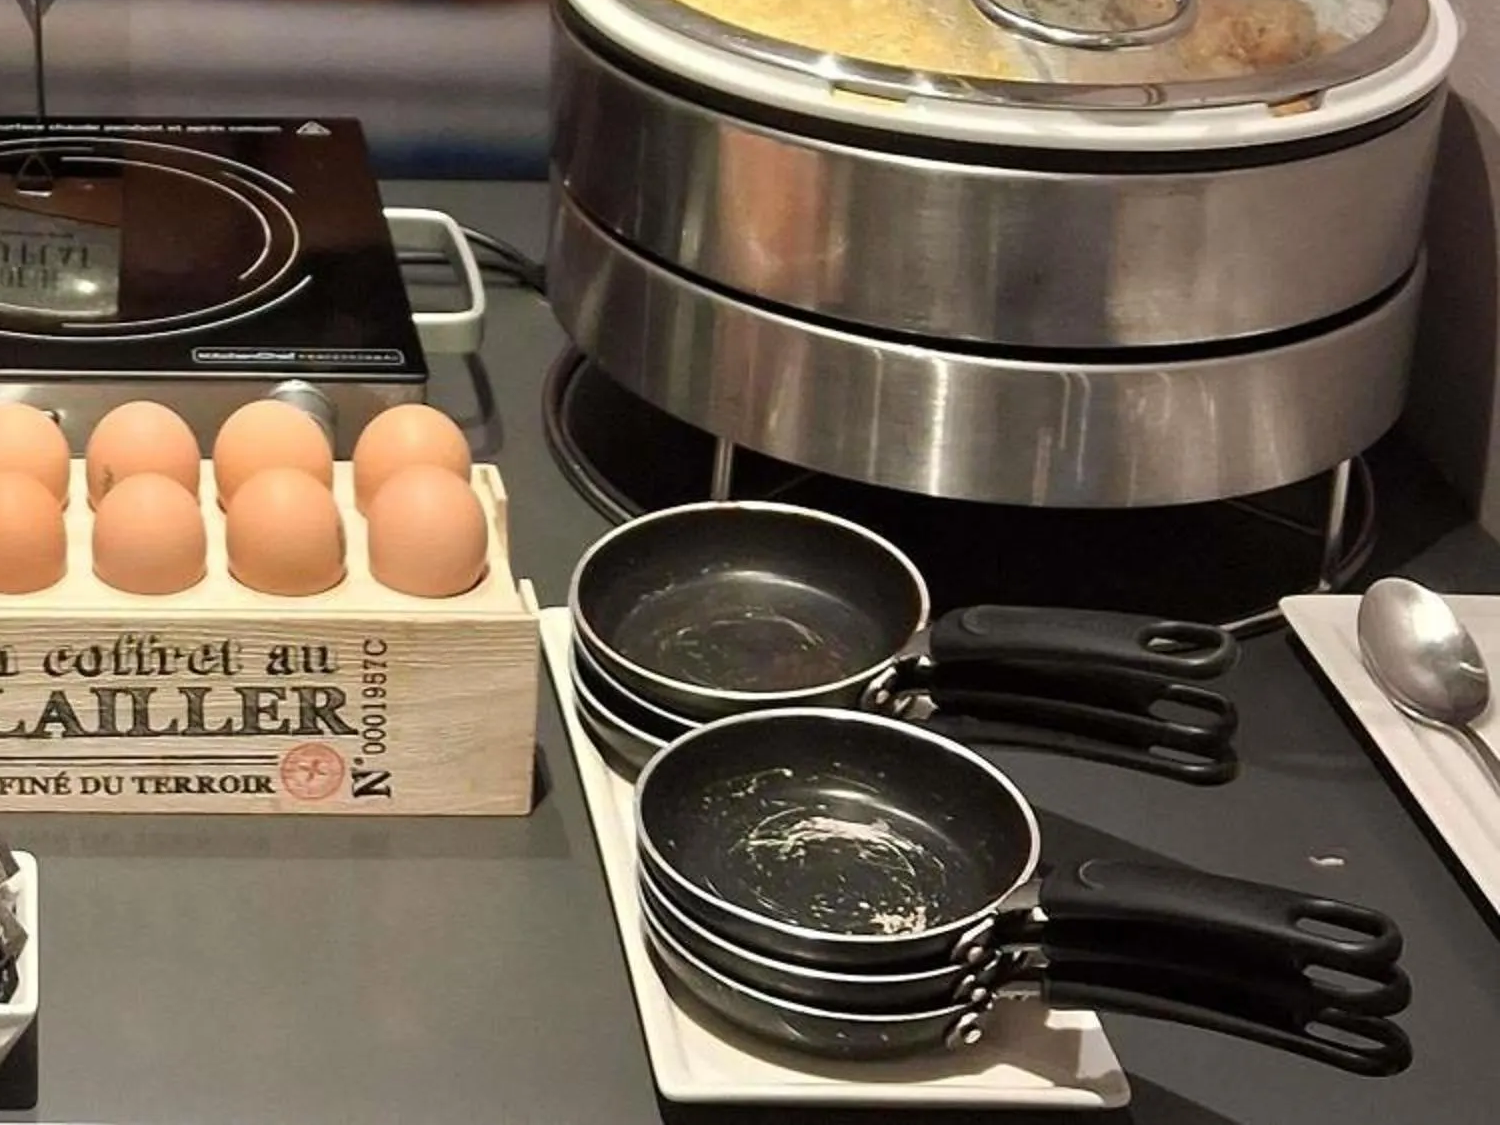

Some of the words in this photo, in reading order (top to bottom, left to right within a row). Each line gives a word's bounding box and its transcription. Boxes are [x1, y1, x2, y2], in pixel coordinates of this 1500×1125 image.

[43, 633, 243, 678] coffret
[267, 643, 340, 676] au
[80, 776, 124, 795] DU
[131, 776, 278, 795] TERROIR
